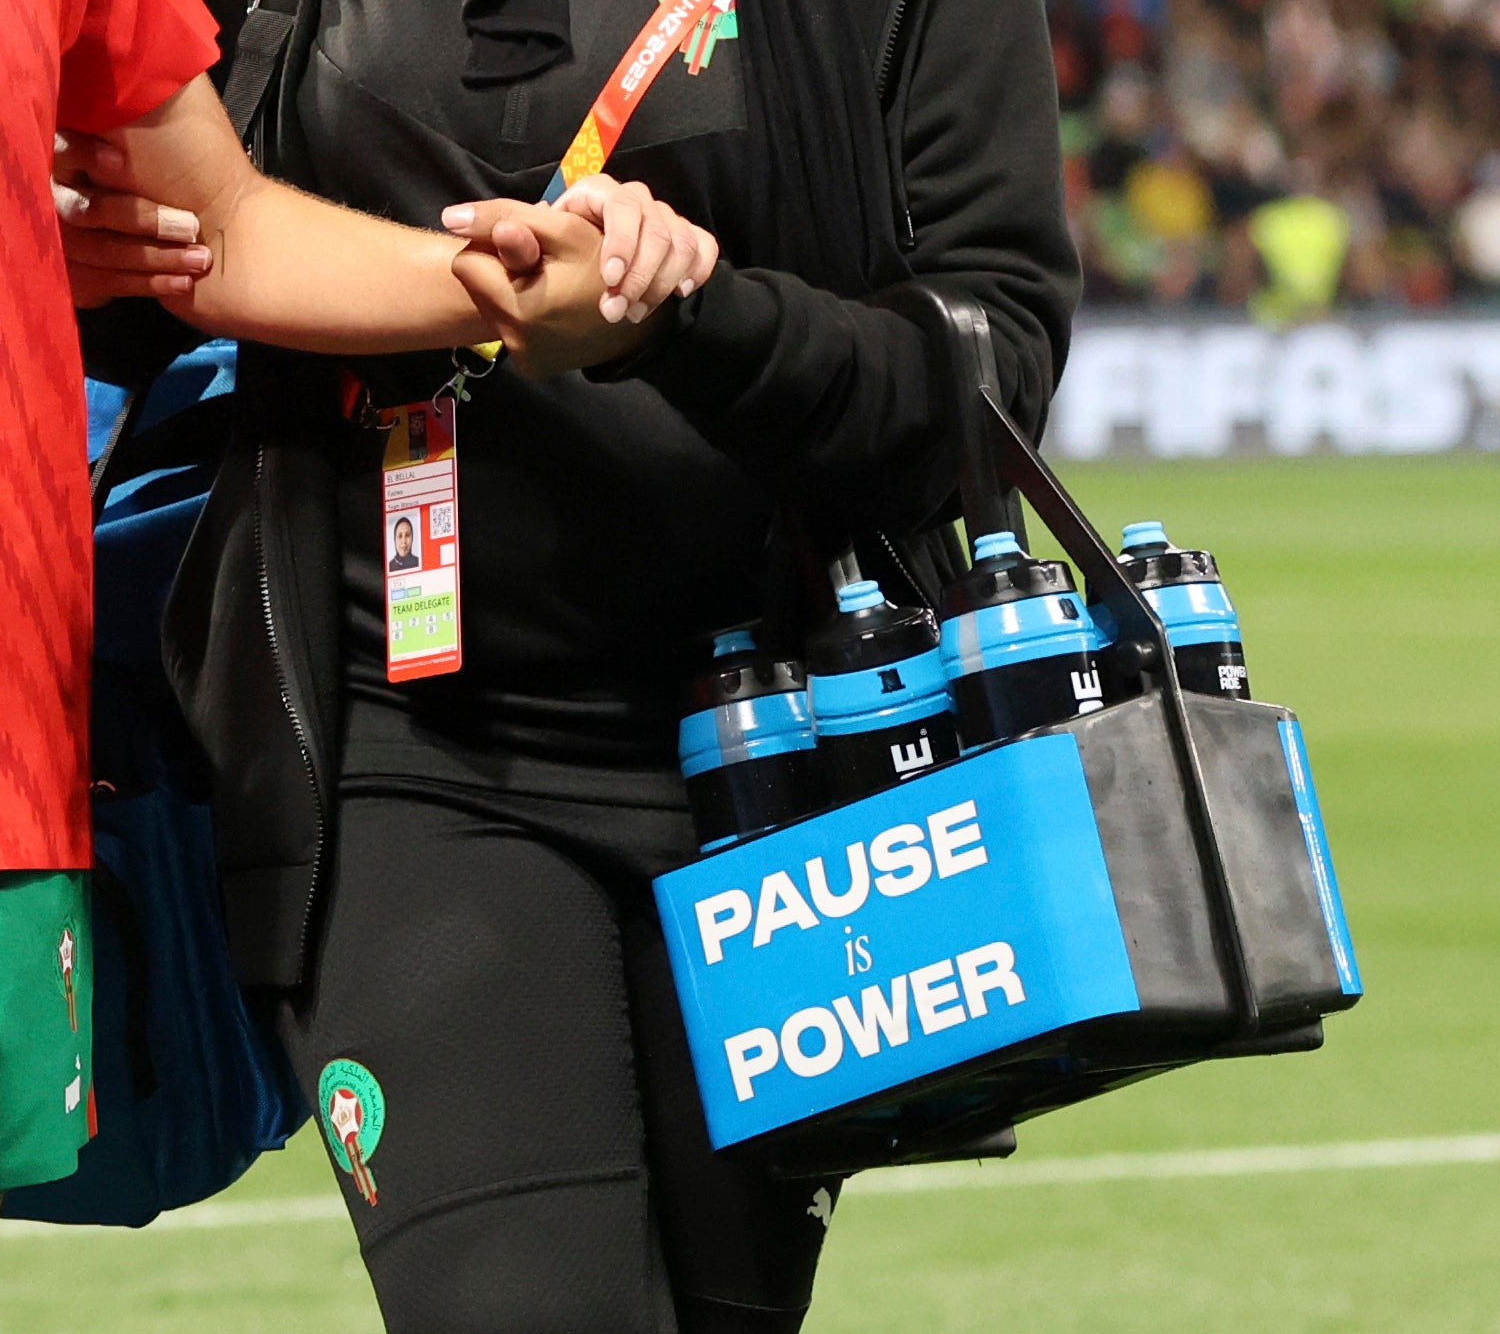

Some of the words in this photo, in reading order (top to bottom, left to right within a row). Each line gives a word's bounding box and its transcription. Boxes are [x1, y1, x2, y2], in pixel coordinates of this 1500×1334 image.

[393, 603, 413, 615] TEAM
[414, 596, 450, 612] DELEGATE
[694, 799, 989, 966] PAUSE
[844, 925, 873, 977] is
[723, 941, 1027, 1103] POWER
